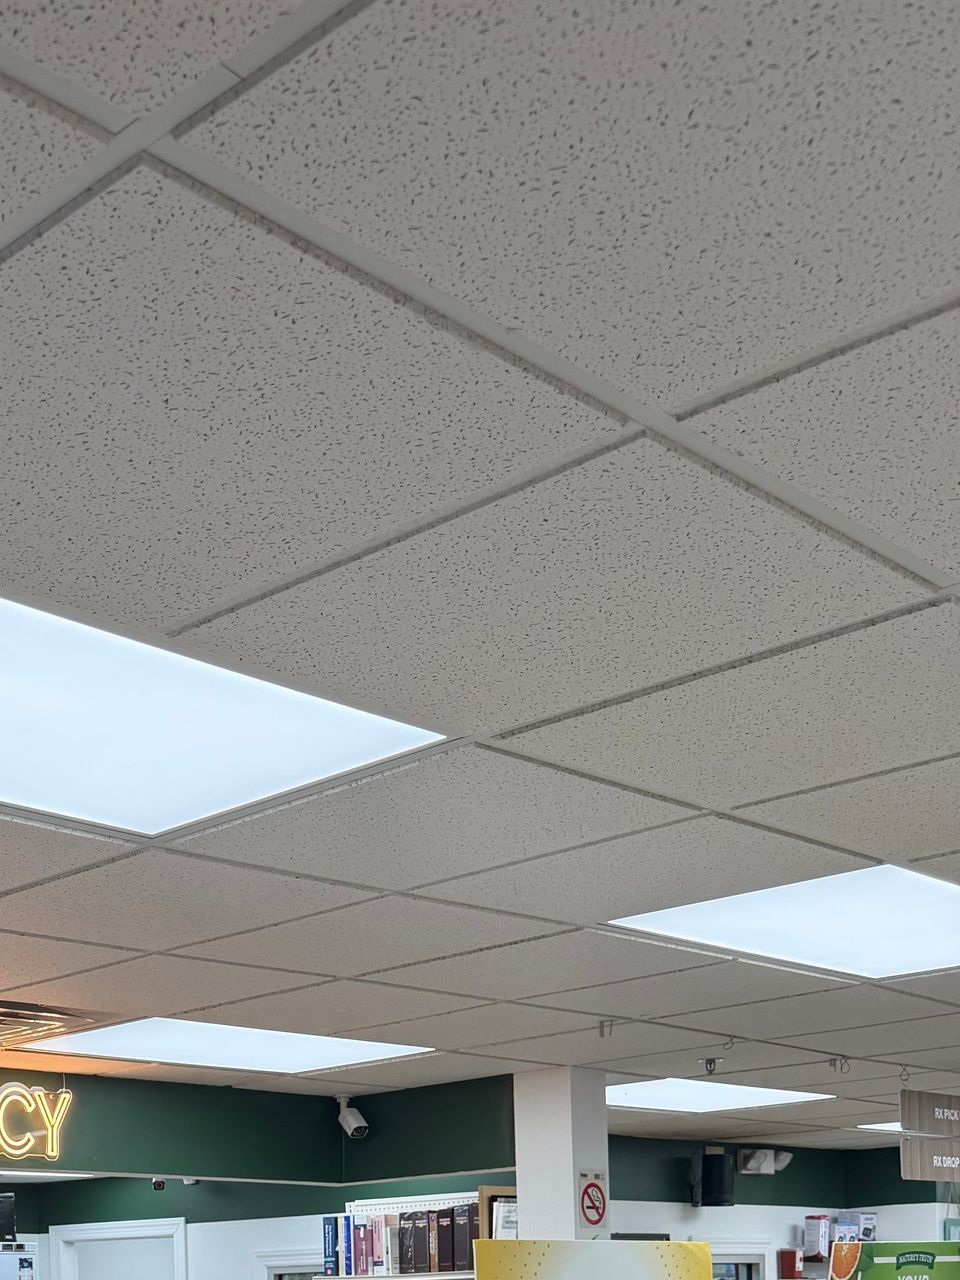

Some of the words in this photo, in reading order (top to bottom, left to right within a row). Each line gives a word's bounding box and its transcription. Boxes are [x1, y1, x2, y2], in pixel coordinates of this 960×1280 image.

[934, 1108, 943, 1119] RX
[933, 1156, 942, 1167] RX
[943, 1157, 960, 1168] DROP
